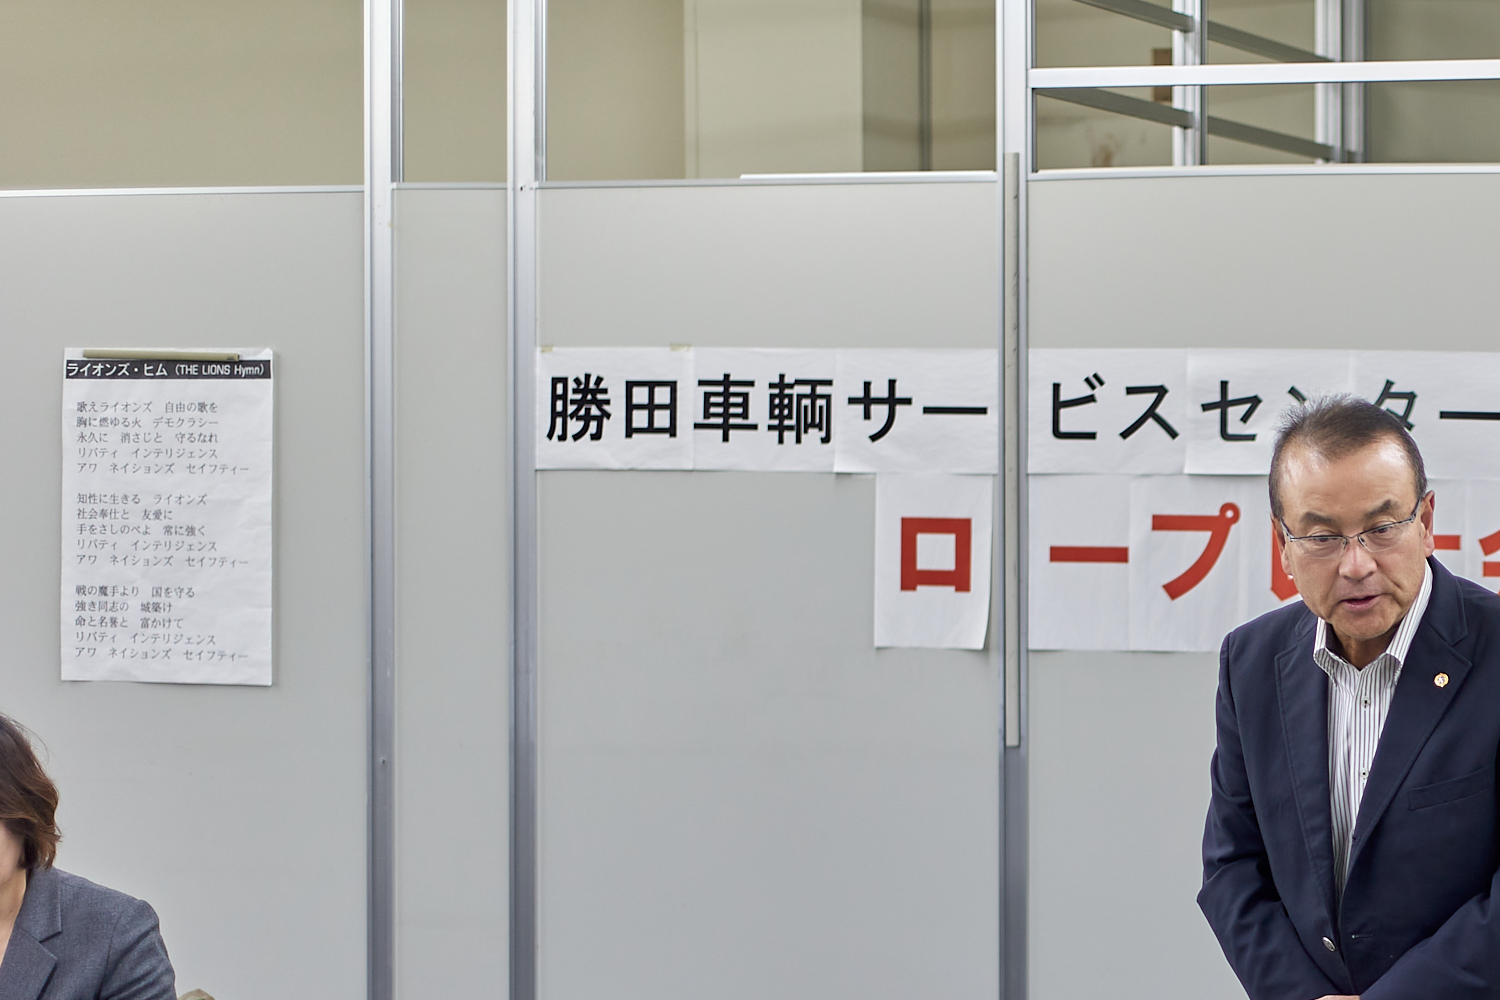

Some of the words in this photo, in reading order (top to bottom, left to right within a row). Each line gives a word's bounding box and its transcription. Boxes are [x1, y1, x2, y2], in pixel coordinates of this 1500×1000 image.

[67, 363, 168, 377] ライオンズ・ヒム
[202, 364, 230, 375] LIONS
[77, 402, 153, 413] 歌えライオンズ
[165, 402, 218, 413] 自由の歌を
[152, 417, 218, 428] デモクラシー
[77, 433, 108, 443] 永久に
[120, 433, 163, 443] 消さじと
[175, 433, 218, 443] 守るなれ
[77, 448, 118, 458] リバティ
[132, 448, 218, 459] インテリジェンス
[77, 463, 97, 474] アワ
[109, 463, 175, 475] ネイションズ
[186, 463, 249, 475] セイフティー
[77, 493, 141, 505] 知性に生きる
[153, 494, 207, 505] ライオンズ
[76, 509, 130, 520] 社会奉仕と
[142, 509, 173, 521] 友愛に
[76, 524, 151, 536] 手をさしのべよ
[163, 525, 206, 536] 常に強く
[77, 539, 118, 550] リバティ
[131, 540, 217, 552] インテリジェンス
[76, 554, 97, 566] アワ
[109, 555, 173, 567] ネイションズ
[185, 556, 249, 568] セイフティー
[151, 587, 195, 598] 国を守る
[140, 617, 184, 629] 富かけて
[75, 632, 117, 643] リバティ
[130, 633, 216, 645] インテリジェンス
[75, 647, 97, 658] アワ
[109, 648, 171, 660] ネイションズ
[183, 649, 248, 662] セイフティー
